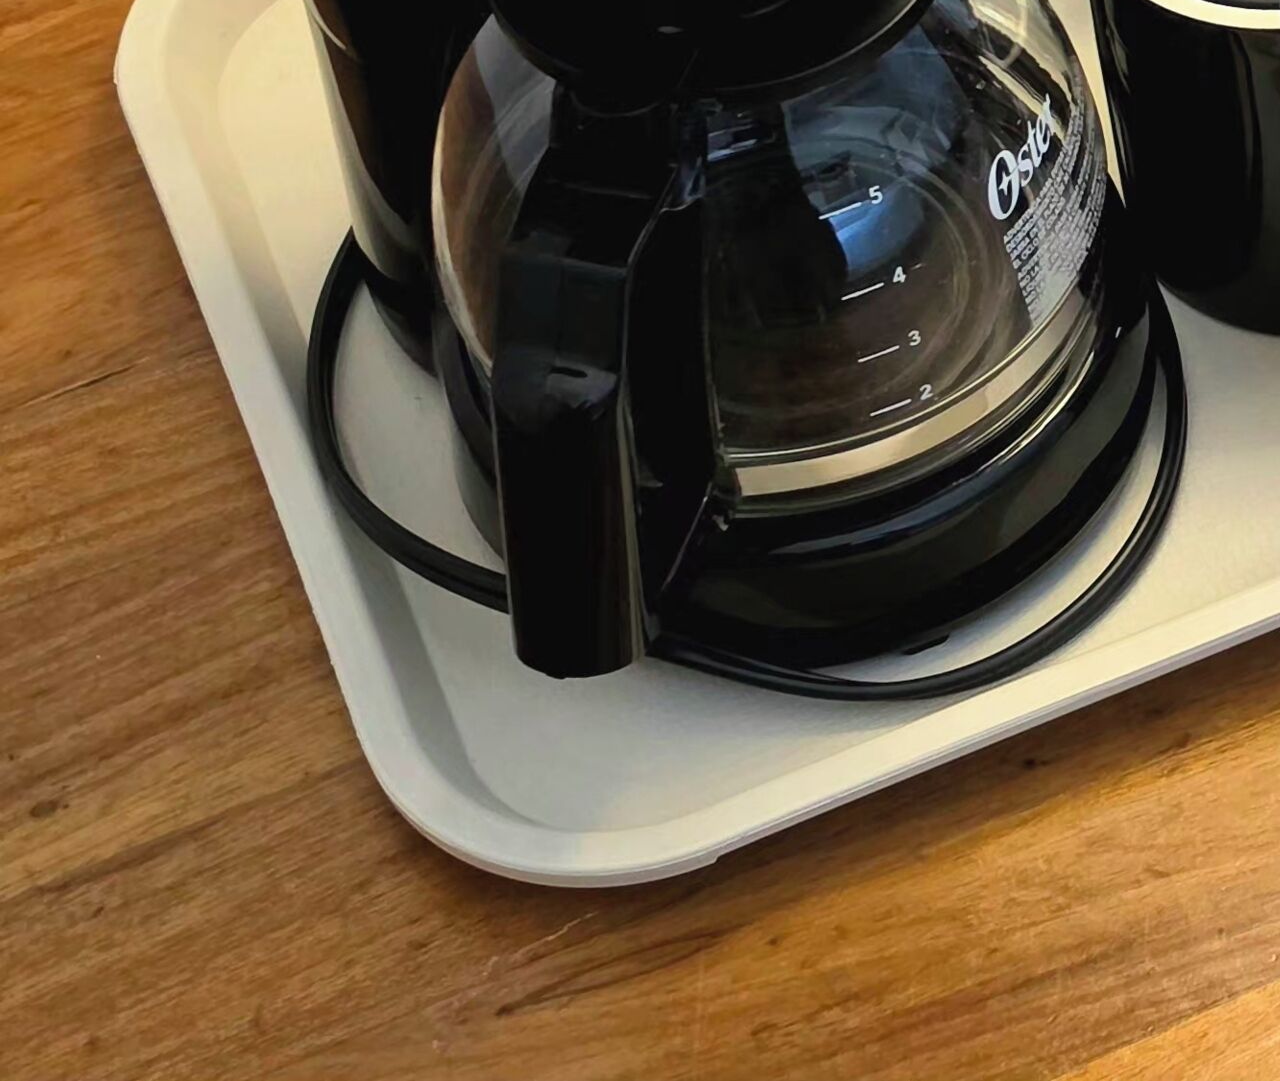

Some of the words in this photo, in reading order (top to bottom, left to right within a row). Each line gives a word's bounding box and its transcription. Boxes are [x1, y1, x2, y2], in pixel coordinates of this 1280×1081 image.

[988, 92, 1056, 220] Oster
[868, 185, 883, 204] 5
[892, 266, 907, 284] 4
[908, 330, 922, 346] 3
[919, 384, 934, 400] 2
